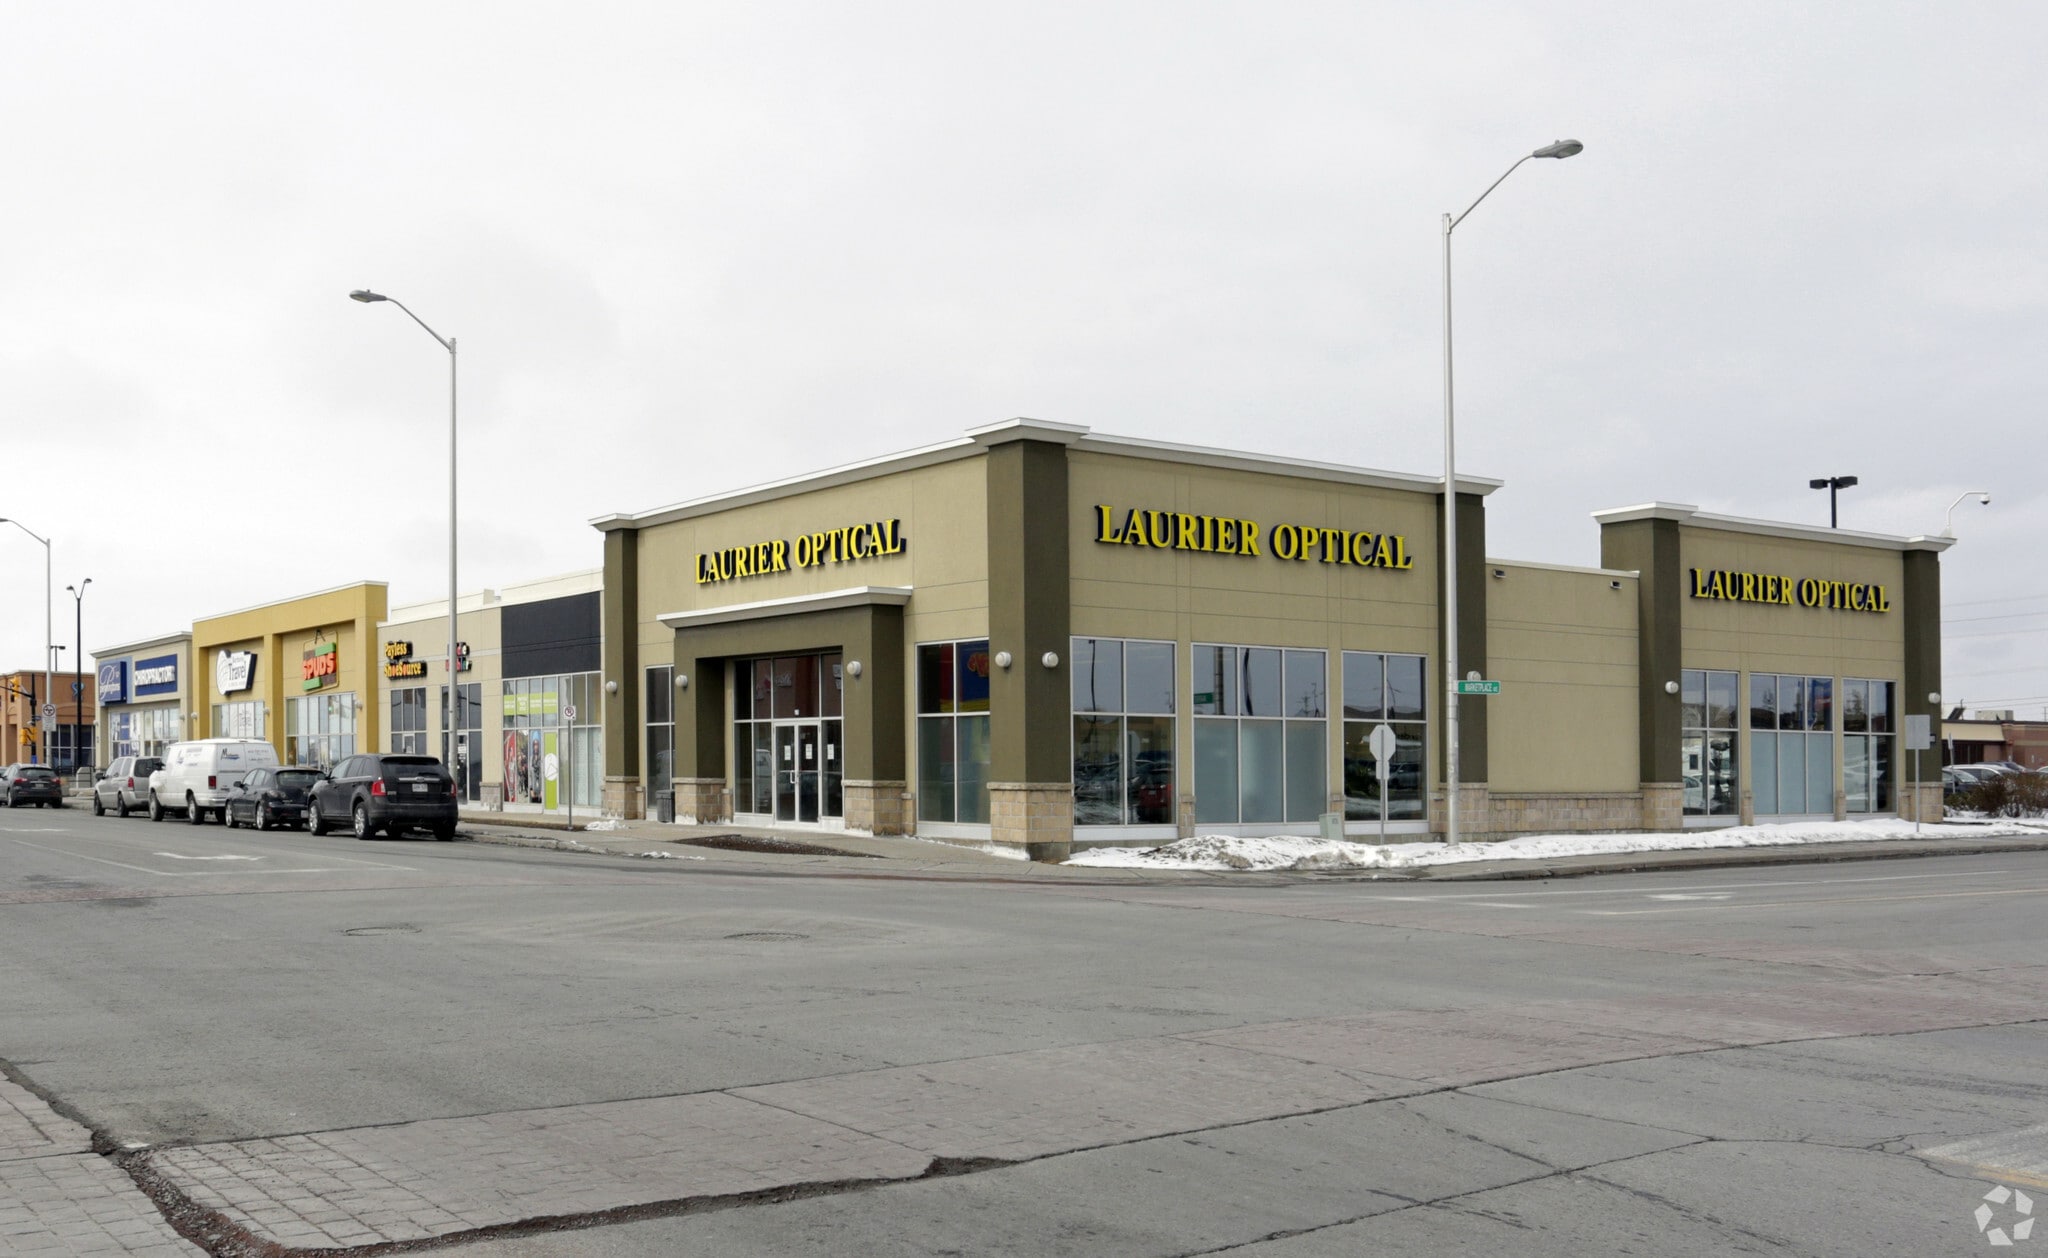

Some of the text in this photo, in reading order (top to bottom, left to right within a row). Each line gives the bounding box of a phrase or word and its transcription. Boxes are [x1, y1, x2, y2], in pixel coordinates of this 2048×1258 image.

[695, 518, 905, 584] LAURIER OPTICAL
[1096, 505, 1413, 570] LAURIER OPTICAL
[1692, 568, 1890, 612] LAURIER OPTICAL
[384, 642, 409, 659] Payless
[228, 660, 247, 681] Travel
[302, 652, 336, 680] SPUDS
[1464, 682, 1493, 692] MARKETPLACE
